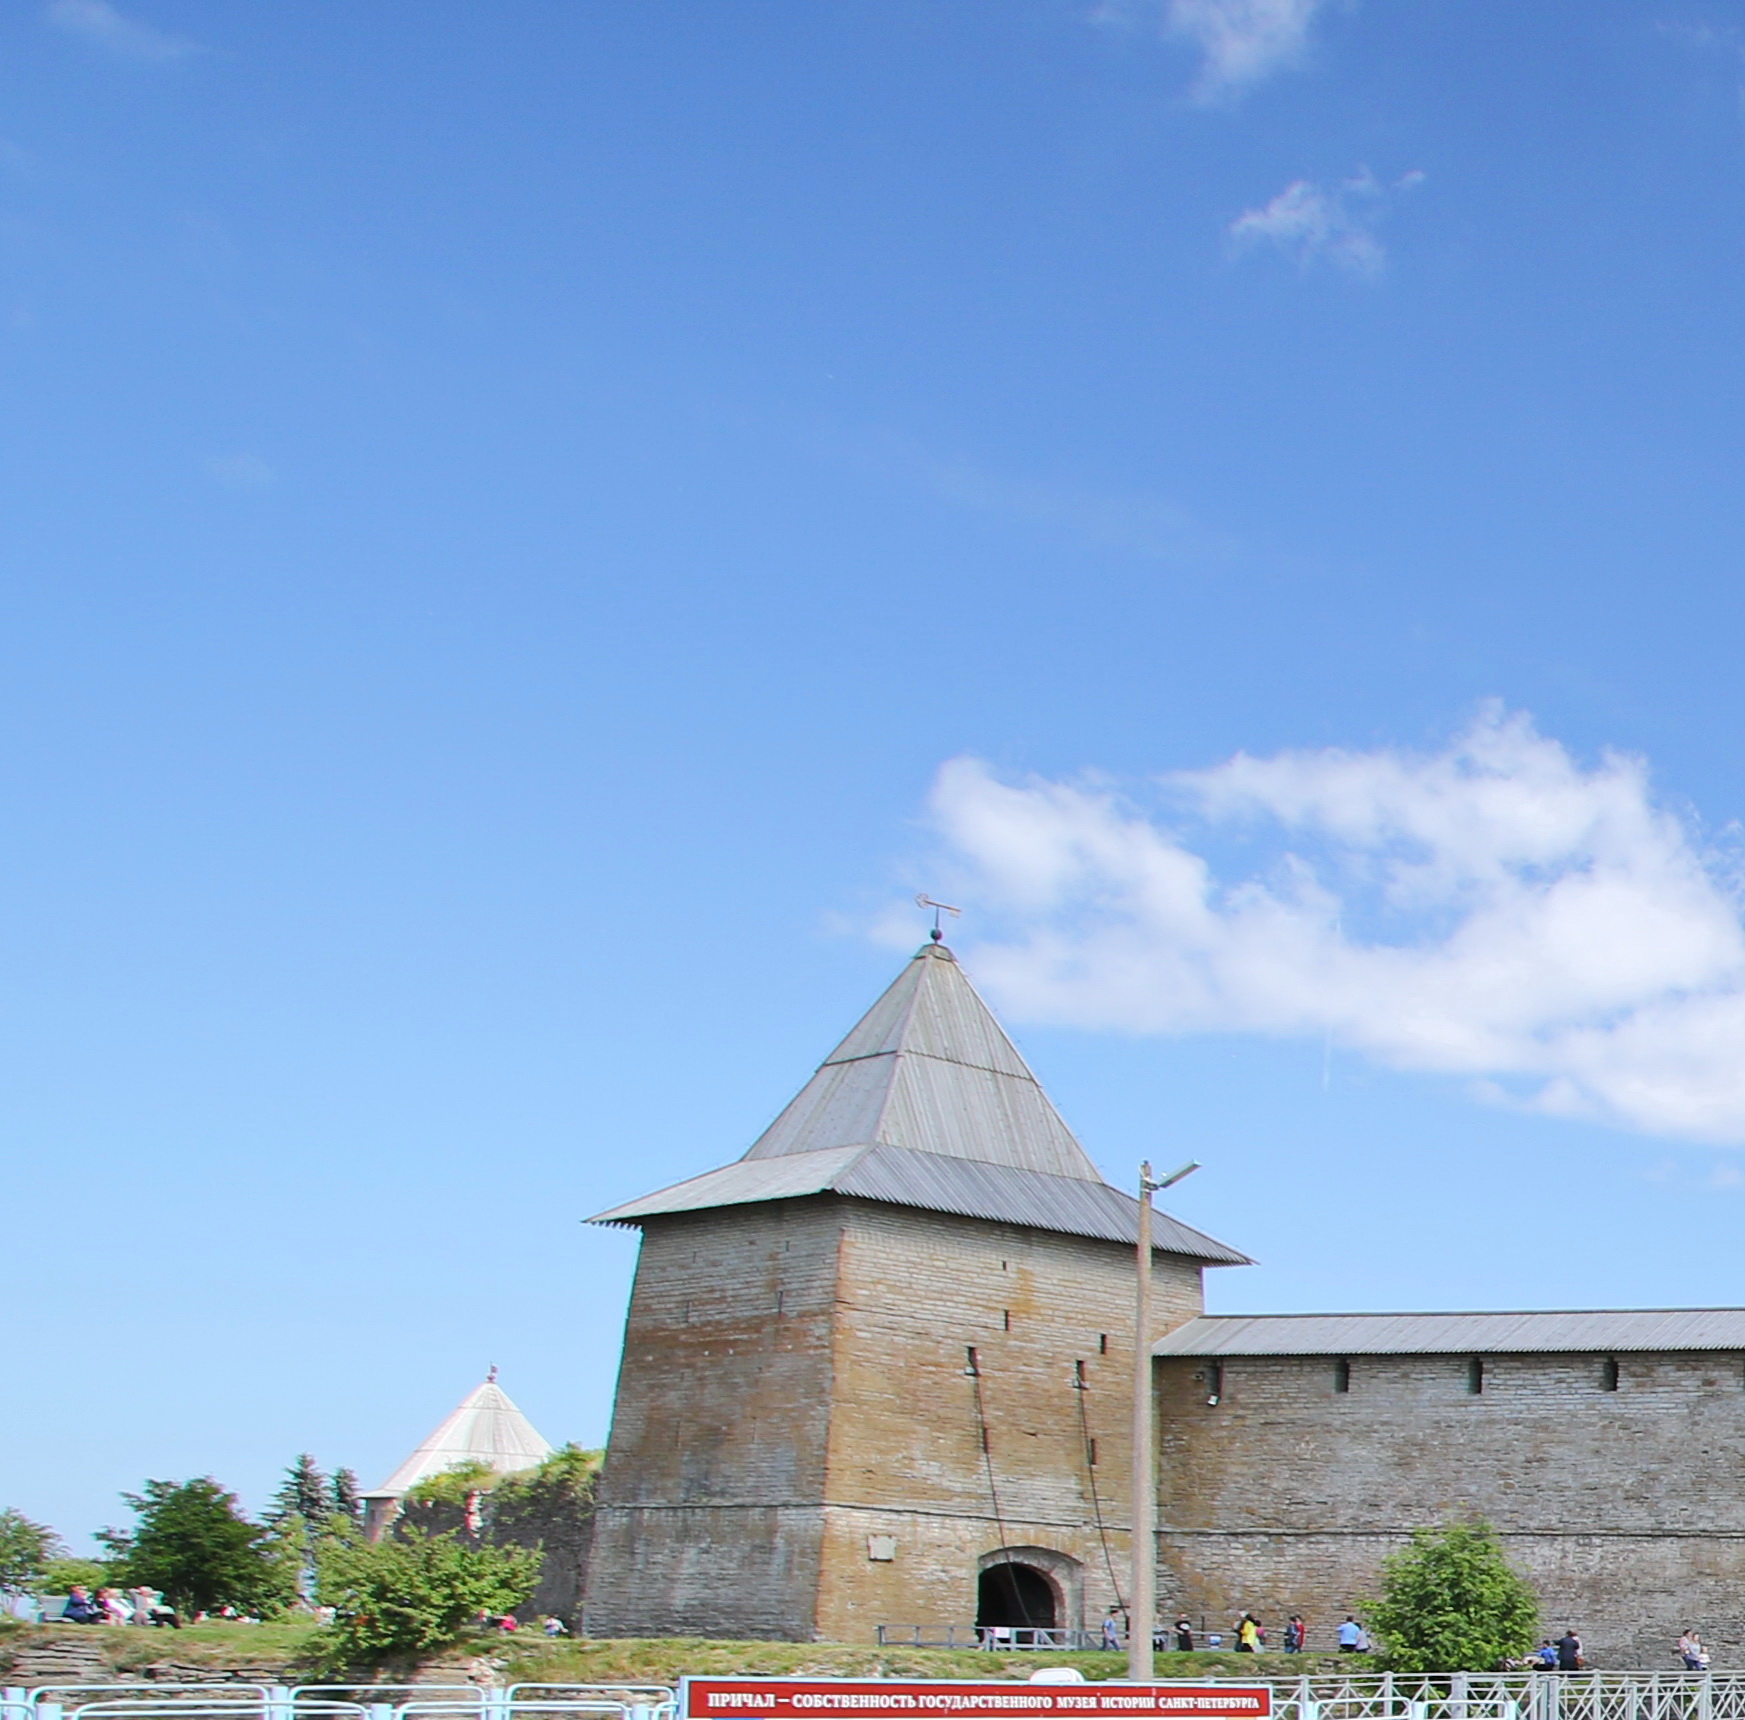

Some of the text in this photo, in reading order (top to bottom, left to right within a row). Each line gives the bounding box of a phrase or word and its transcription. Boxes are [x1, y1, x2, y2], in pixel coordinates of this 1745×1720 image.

[707, 1692, 776, 1708] ПРИЧАЛ
[792, 1693, 916, 1709] СОБСТВЕННОСТЬ
[918, 1694, 1053, 1710] ГОСУДАРСТВЕННОГО
[1056, 1695, 1098, 1709] МУЗЕЯ
[1101, 1696, 1156, 1709] ИСТОРИИ
[1158, 1696, 1260, 1709] САНКТ-ПЕТЕРБУРГА
